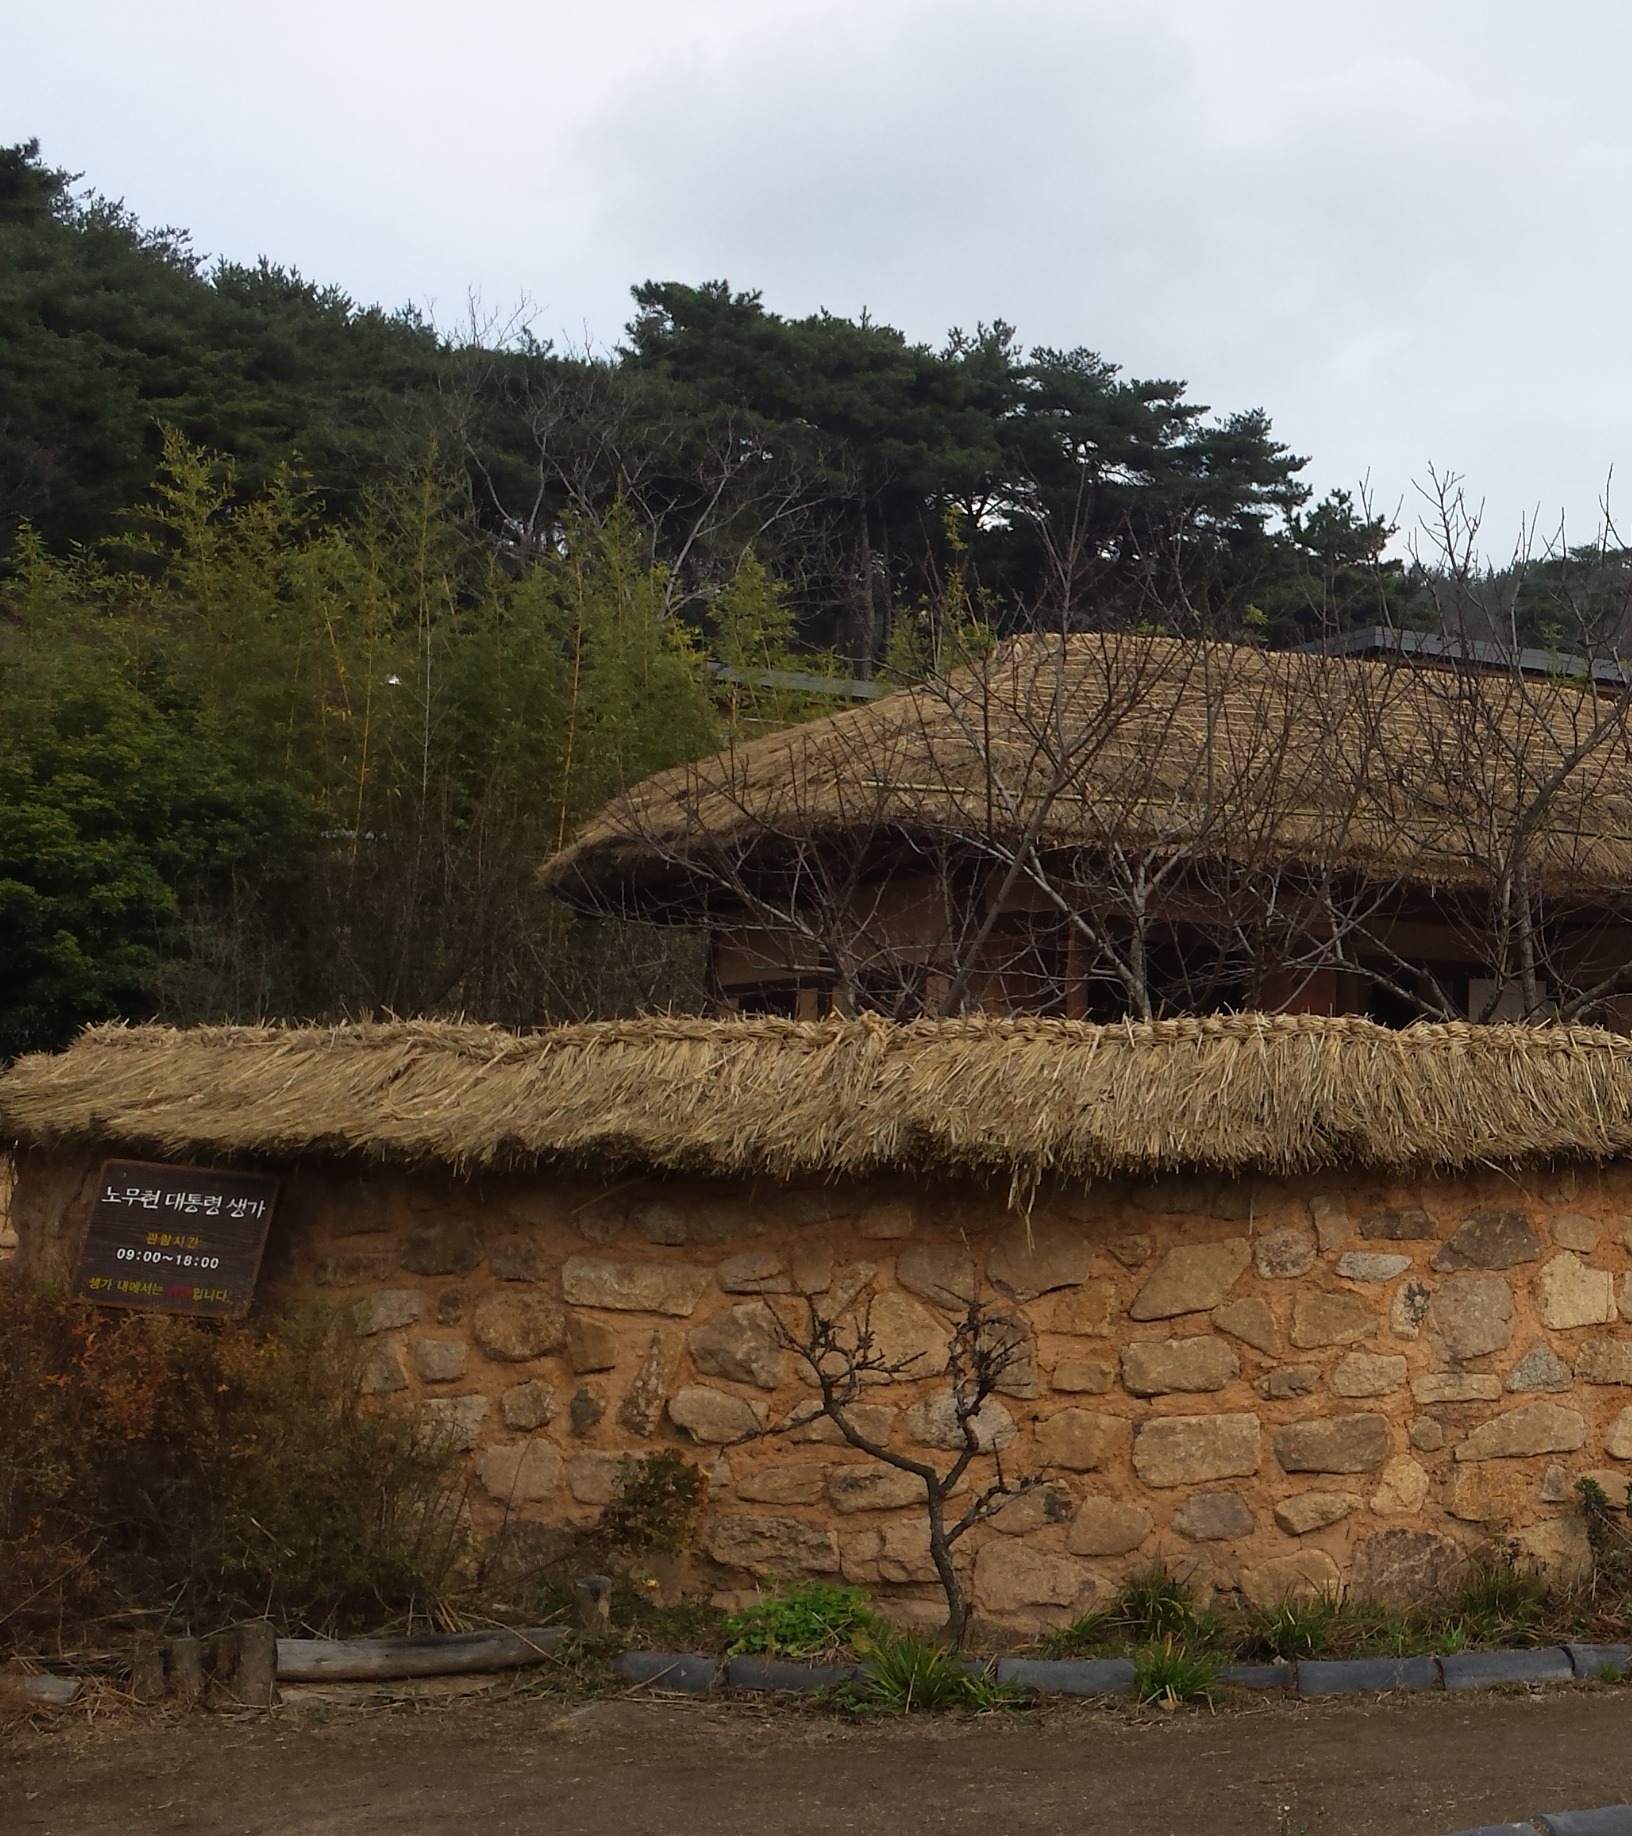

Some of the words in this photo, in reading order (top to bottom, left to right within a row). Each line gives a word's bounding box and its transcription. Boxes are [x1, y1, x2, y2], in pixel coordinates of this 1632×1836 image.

[101, 1186, 161, 1209] 노무현
[165, 1192, 222, 1215] 대통령
[226, 1198, 266, 1218] 생가
[145, 1232, 199, 1248] 관람시간
[116, 1248, 219, 1269] 09:00~18:00
[88, 1277, 112, 1290] 생가
[117, 1281, 163, 1295] 내에서는
